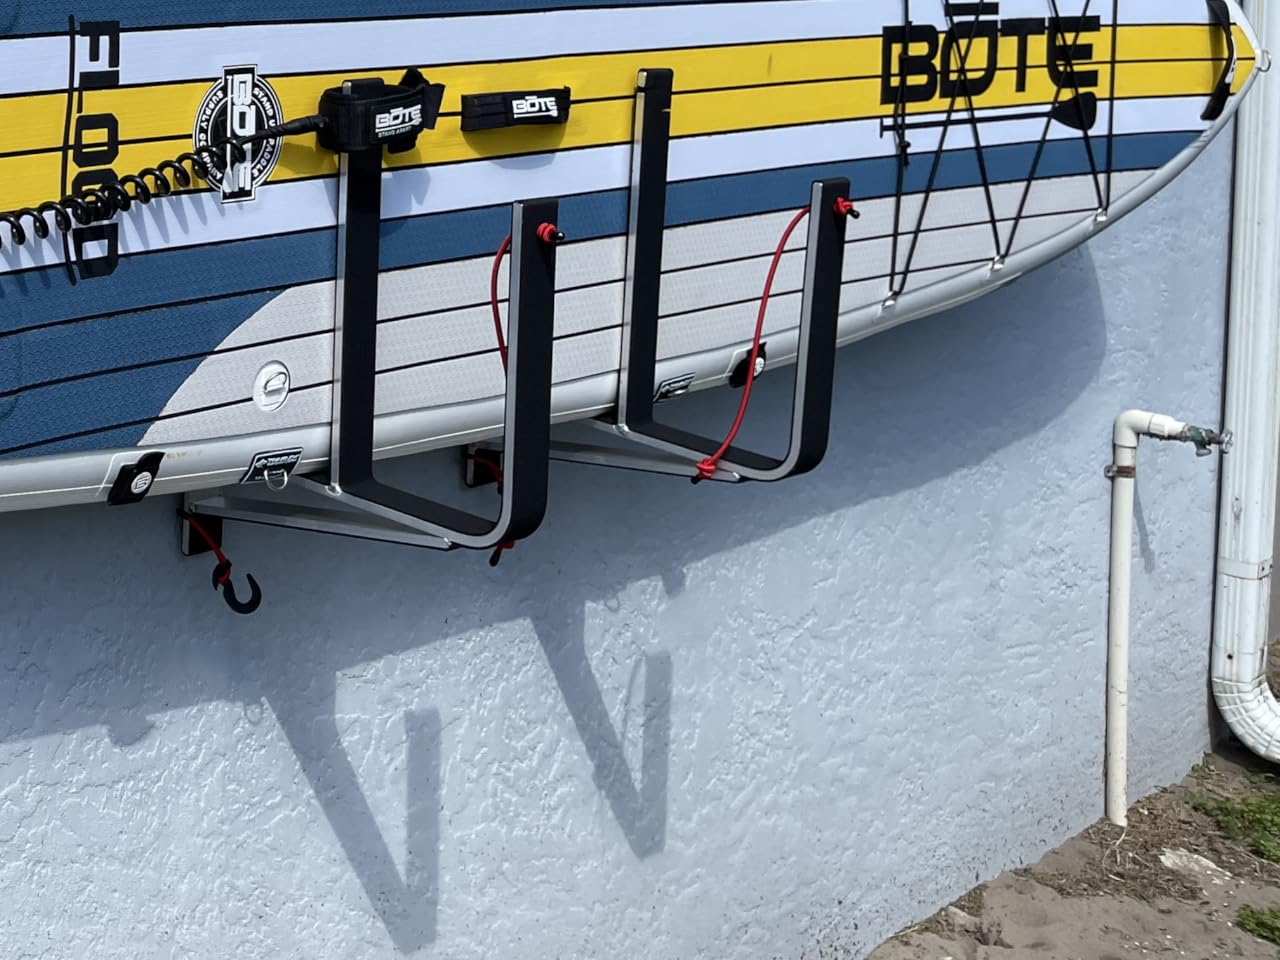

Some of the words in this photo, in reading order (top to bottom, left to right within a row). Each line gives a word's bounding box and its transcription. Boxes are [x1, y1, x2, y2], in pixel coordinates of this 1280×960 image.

[200, 90, 224, 130] SUPPLY
[253, 87, 274, 115] STAND
[252, 138, 275, 177] PADDLE
